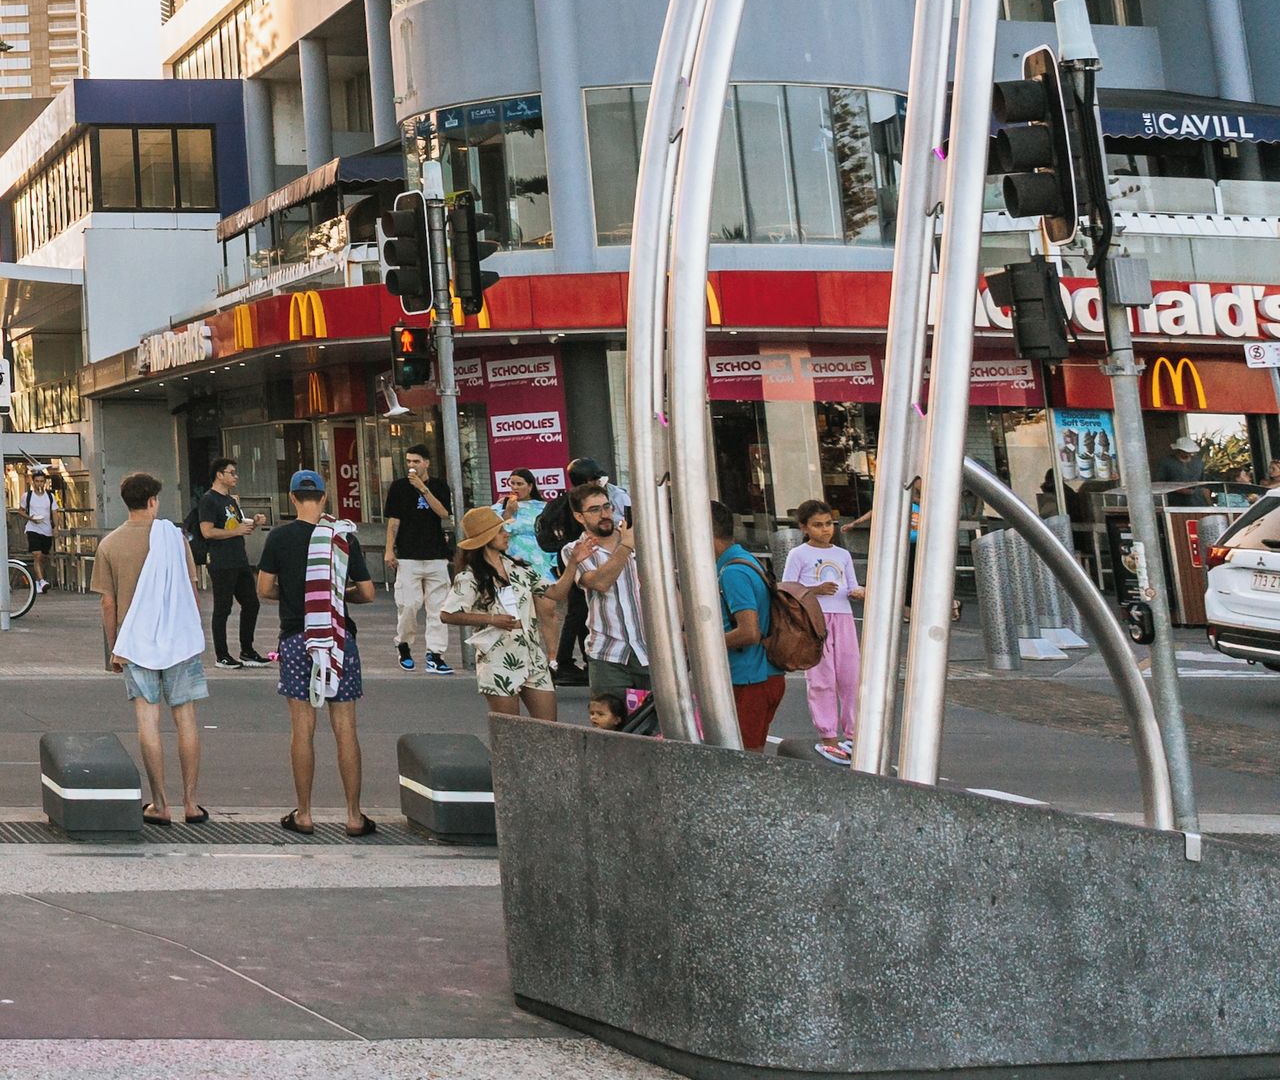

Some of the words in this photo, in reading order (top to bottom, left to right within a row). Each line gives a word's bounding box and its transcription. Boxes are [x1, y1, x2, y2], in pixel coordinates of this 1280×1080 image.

[1142, 112, 1153, 134] ONE
[1158, 112, 1254, 138] CAVILL
[491, 361, 551, 377] SCHOOLIES
[812, 361, 867, 373] CHOOLIES
[531, 377, 558, 387] .COM
[849, 376, 875, 386] .COM
[1010, 380, 1036, 390] .COM
[496, 417, 555, 432] SCHOOLIES
[535, 433, 562, 443] .COM
[1253, 574, 1267, 587] 773
